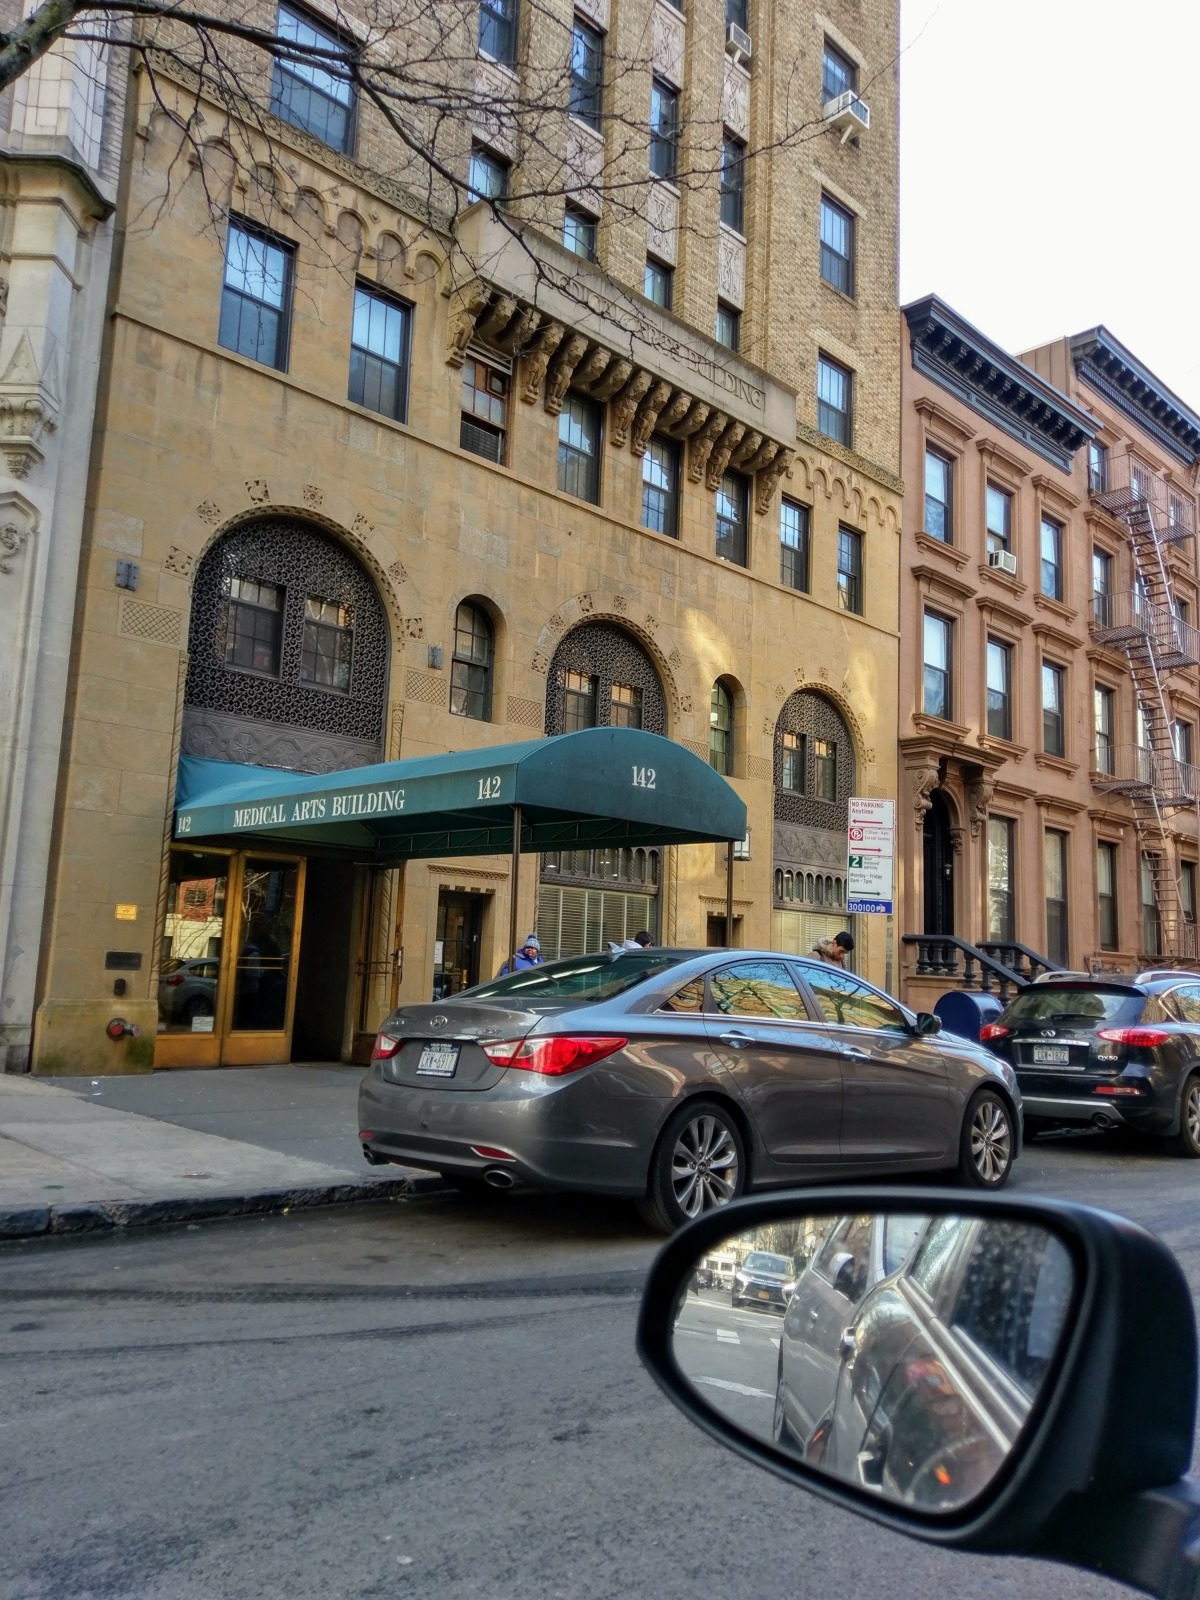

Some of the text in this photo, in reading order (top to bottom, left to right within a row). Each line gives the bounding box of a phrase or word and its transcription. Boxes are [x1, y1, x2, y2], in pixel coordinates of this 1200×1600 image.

[686, 347, 765, 411] BUILDING
[477, 775, 501, 800] 142
[631, 765, 656, 789] 142
[233, 789, 406, 828] MEDICAL ARTS BUILDING
[177, 817, 191, 833] 142
[852, 856, 859, 867] 2
[849, 903, 875, 912] 300100
